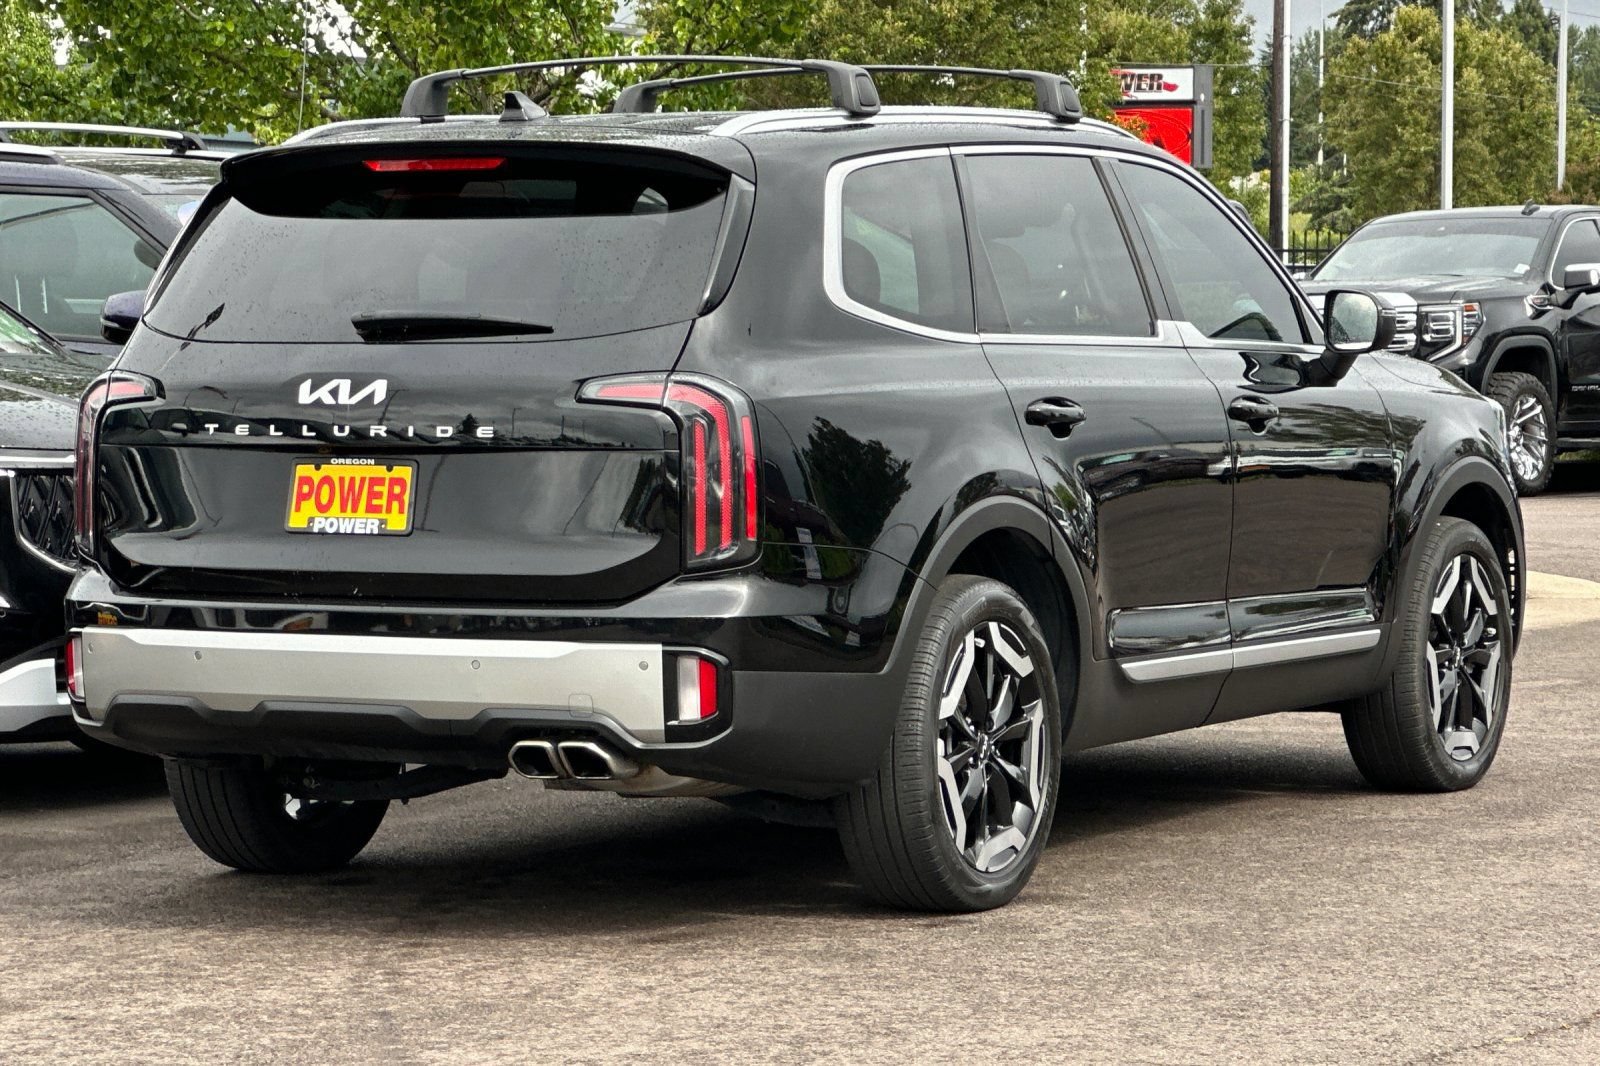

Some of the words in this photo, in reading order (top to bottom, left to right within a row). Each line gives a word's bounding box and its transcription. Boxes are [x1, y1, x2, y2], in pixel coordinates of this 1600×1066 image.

[298, 379, 388, 405] KIA
[205, 424, 494, 437] TELLURIDE
[294, 475, 408, 514] POWER
[312, 517, 380, 534] POWER
